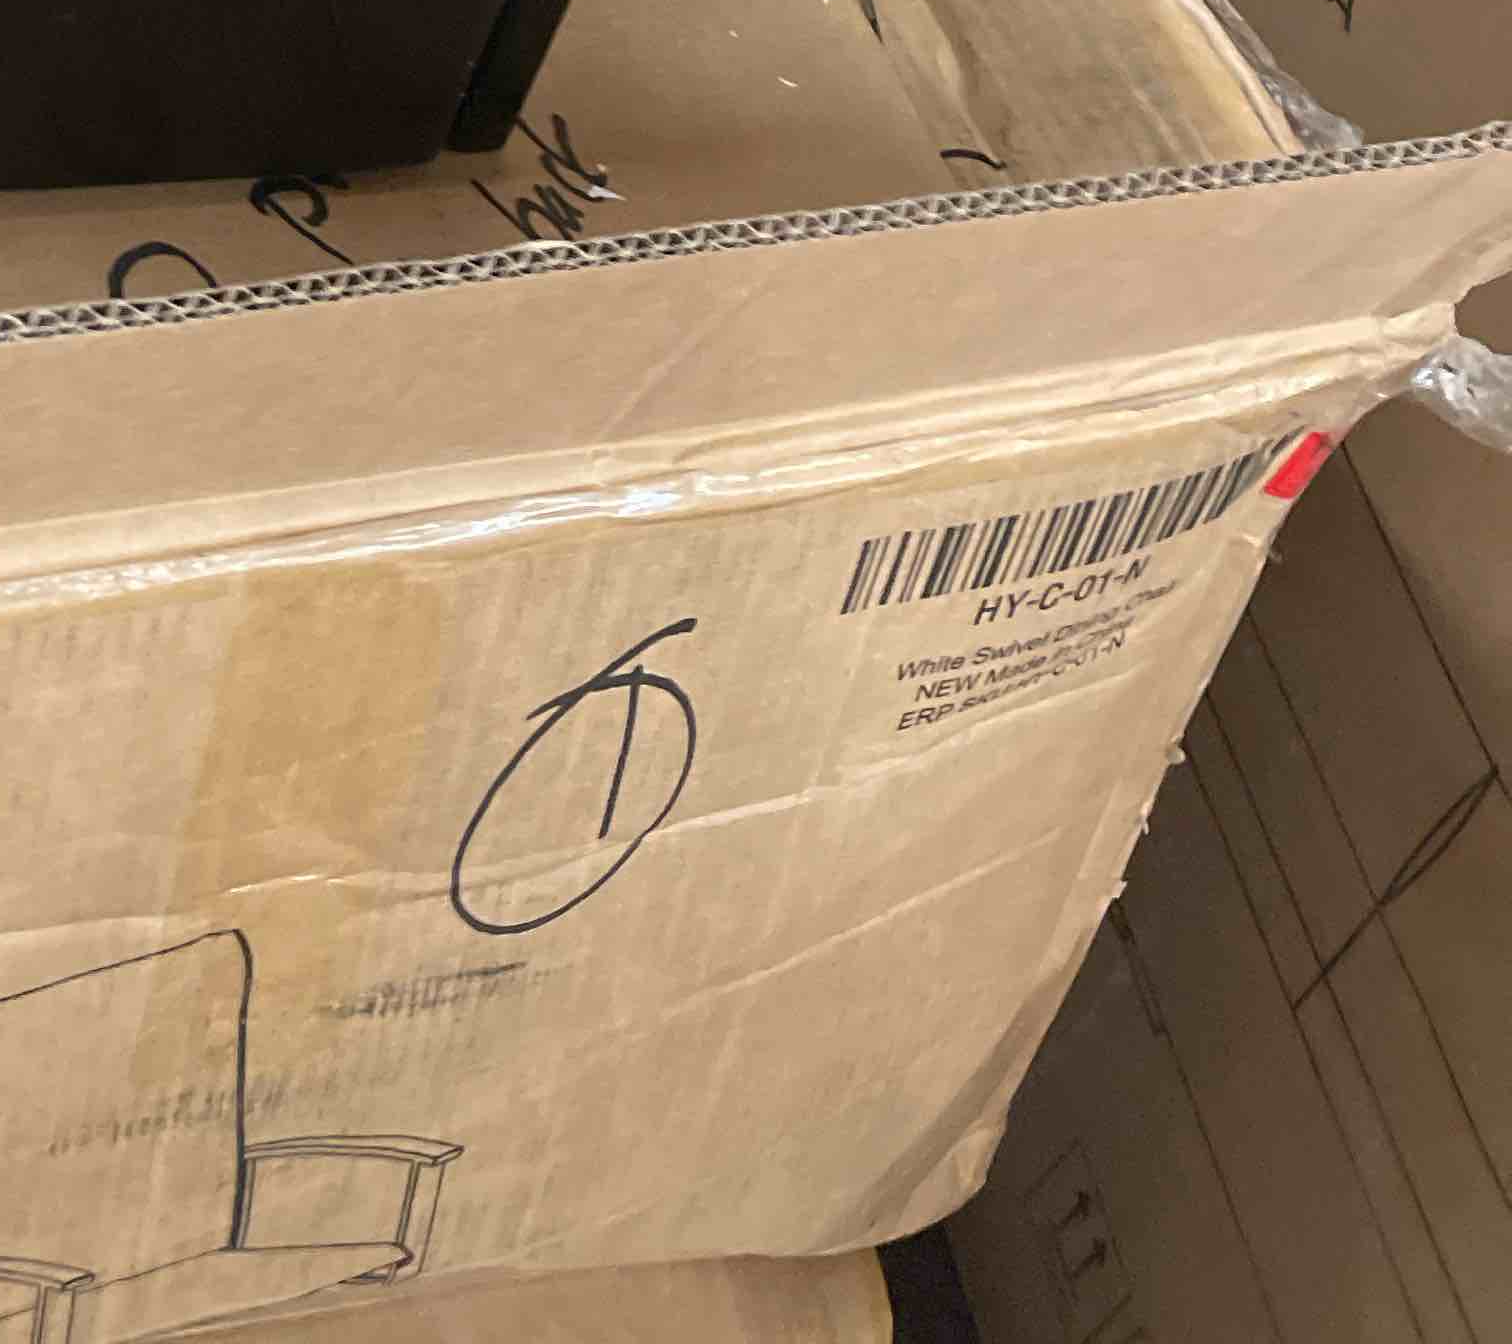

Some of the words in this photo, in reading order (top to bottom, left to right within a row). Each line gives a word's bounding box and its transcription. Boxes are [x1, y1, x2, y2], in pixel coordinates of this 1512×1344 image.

[973, 555, 1151, 625] HY-C-01-N
[898, 655, 964, 681] White
[972, 632, 1050, 664] Swivel
[915, 673, 982, 701] NEW
[987, 655, 1047, 684] Made
[896, 703, 955, 731] ERP
